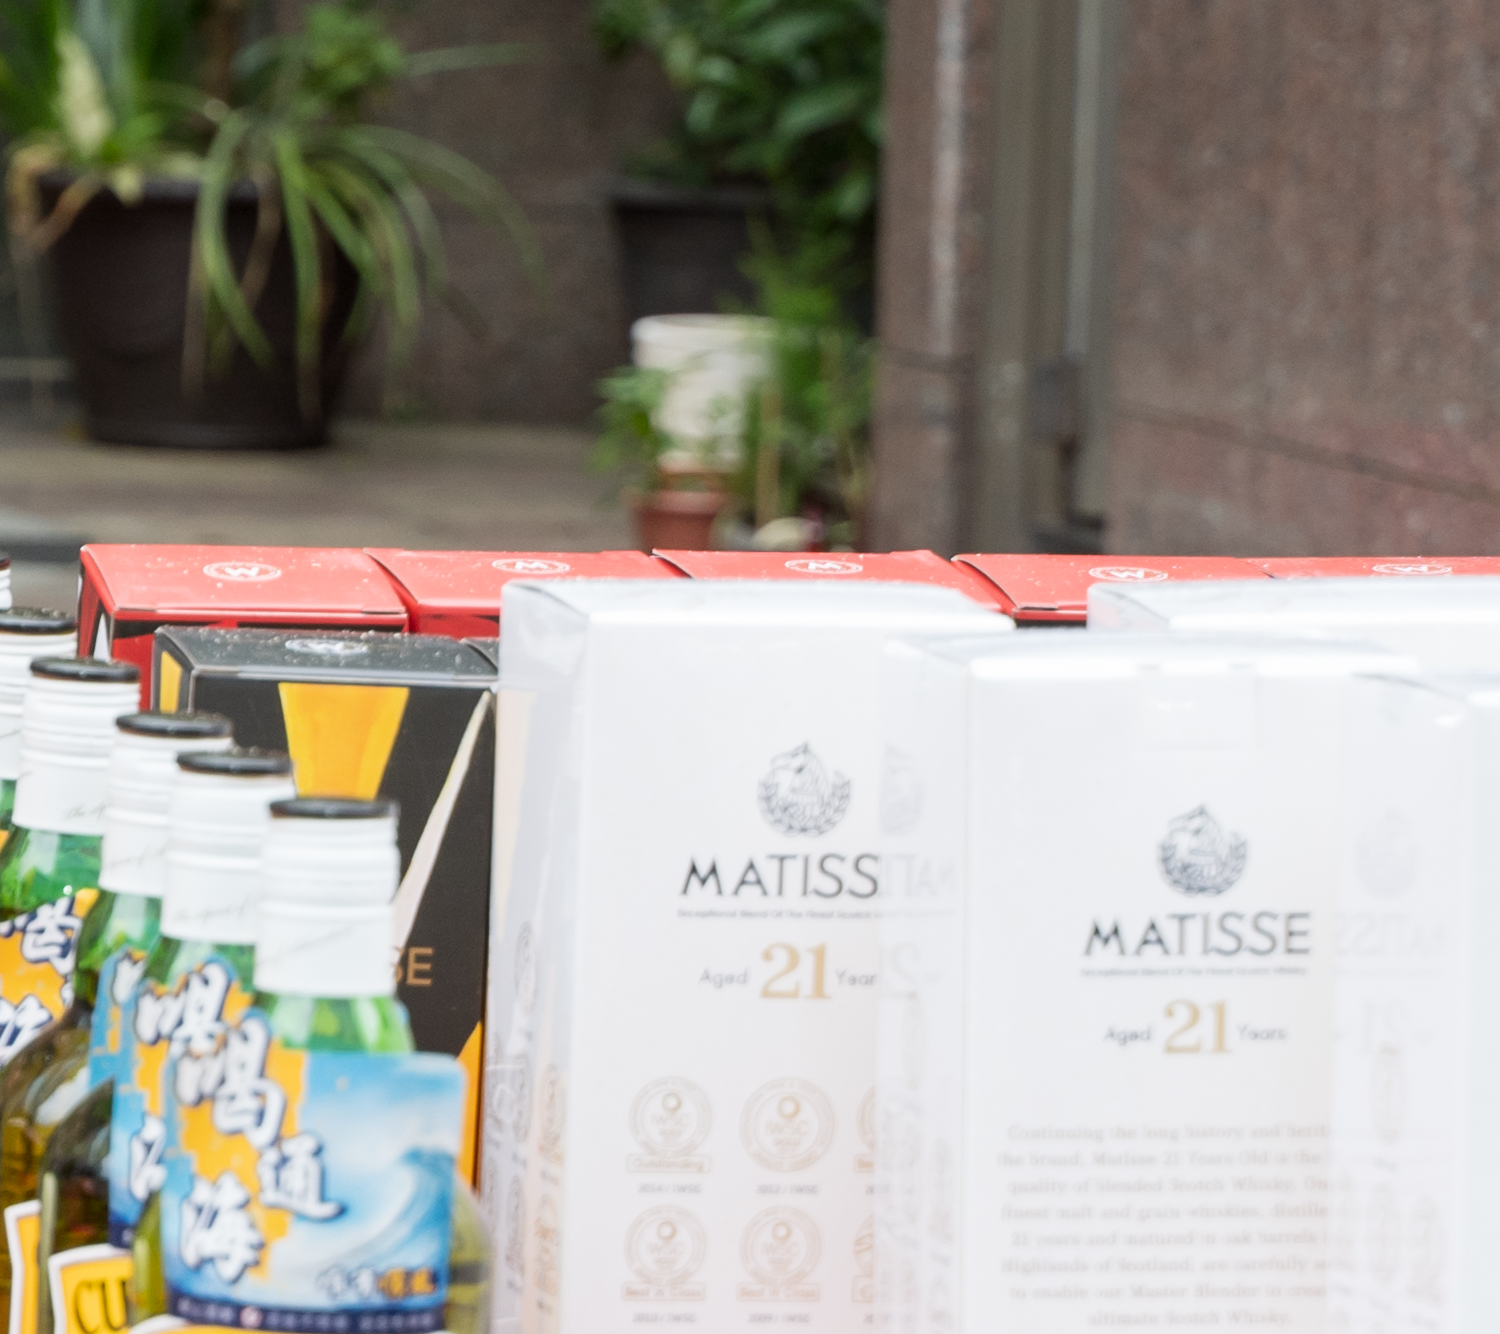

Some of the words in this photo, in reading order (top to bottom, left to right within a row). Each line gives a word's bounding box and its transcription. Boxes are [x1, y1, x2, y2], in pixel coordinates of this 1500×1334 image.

[678, 852, 879, 899] MATISS
[1082, 910, 1312, 957] MATISSE
[699, 968, 749, 989] Aged
[760, 942, 832, 1000] 21
[835, 969, 877, 986] Year
[1104, 1025, 1152, 1047] Aged
[1162, 998, 1232, 1055] 21
[1237, 1025, 1287, 1042] Years
